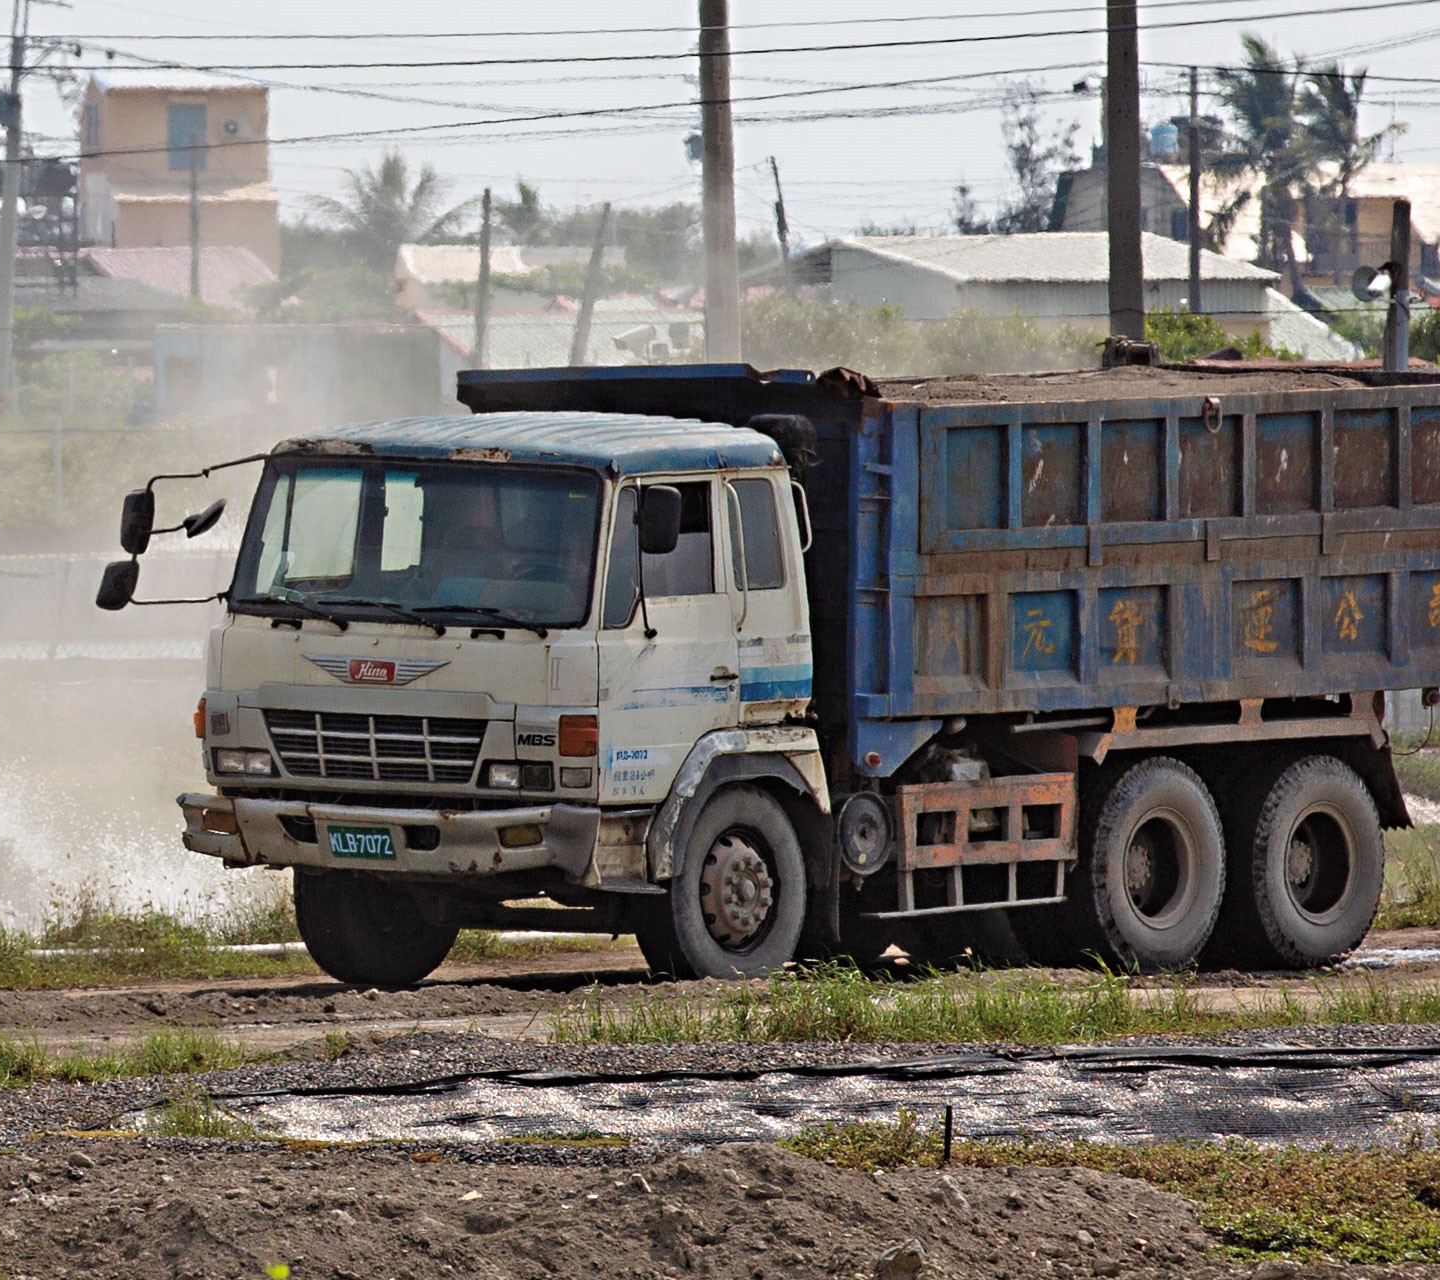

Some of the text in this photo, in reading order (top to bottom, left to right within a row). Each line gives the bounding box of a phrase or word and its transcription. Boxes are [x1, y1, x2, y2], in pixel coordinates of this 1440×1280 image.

[355, 661, 388, 679] Hino
[517, 733, 556, 746] MBS
[328, 832, 394, 855] KLB-7072
